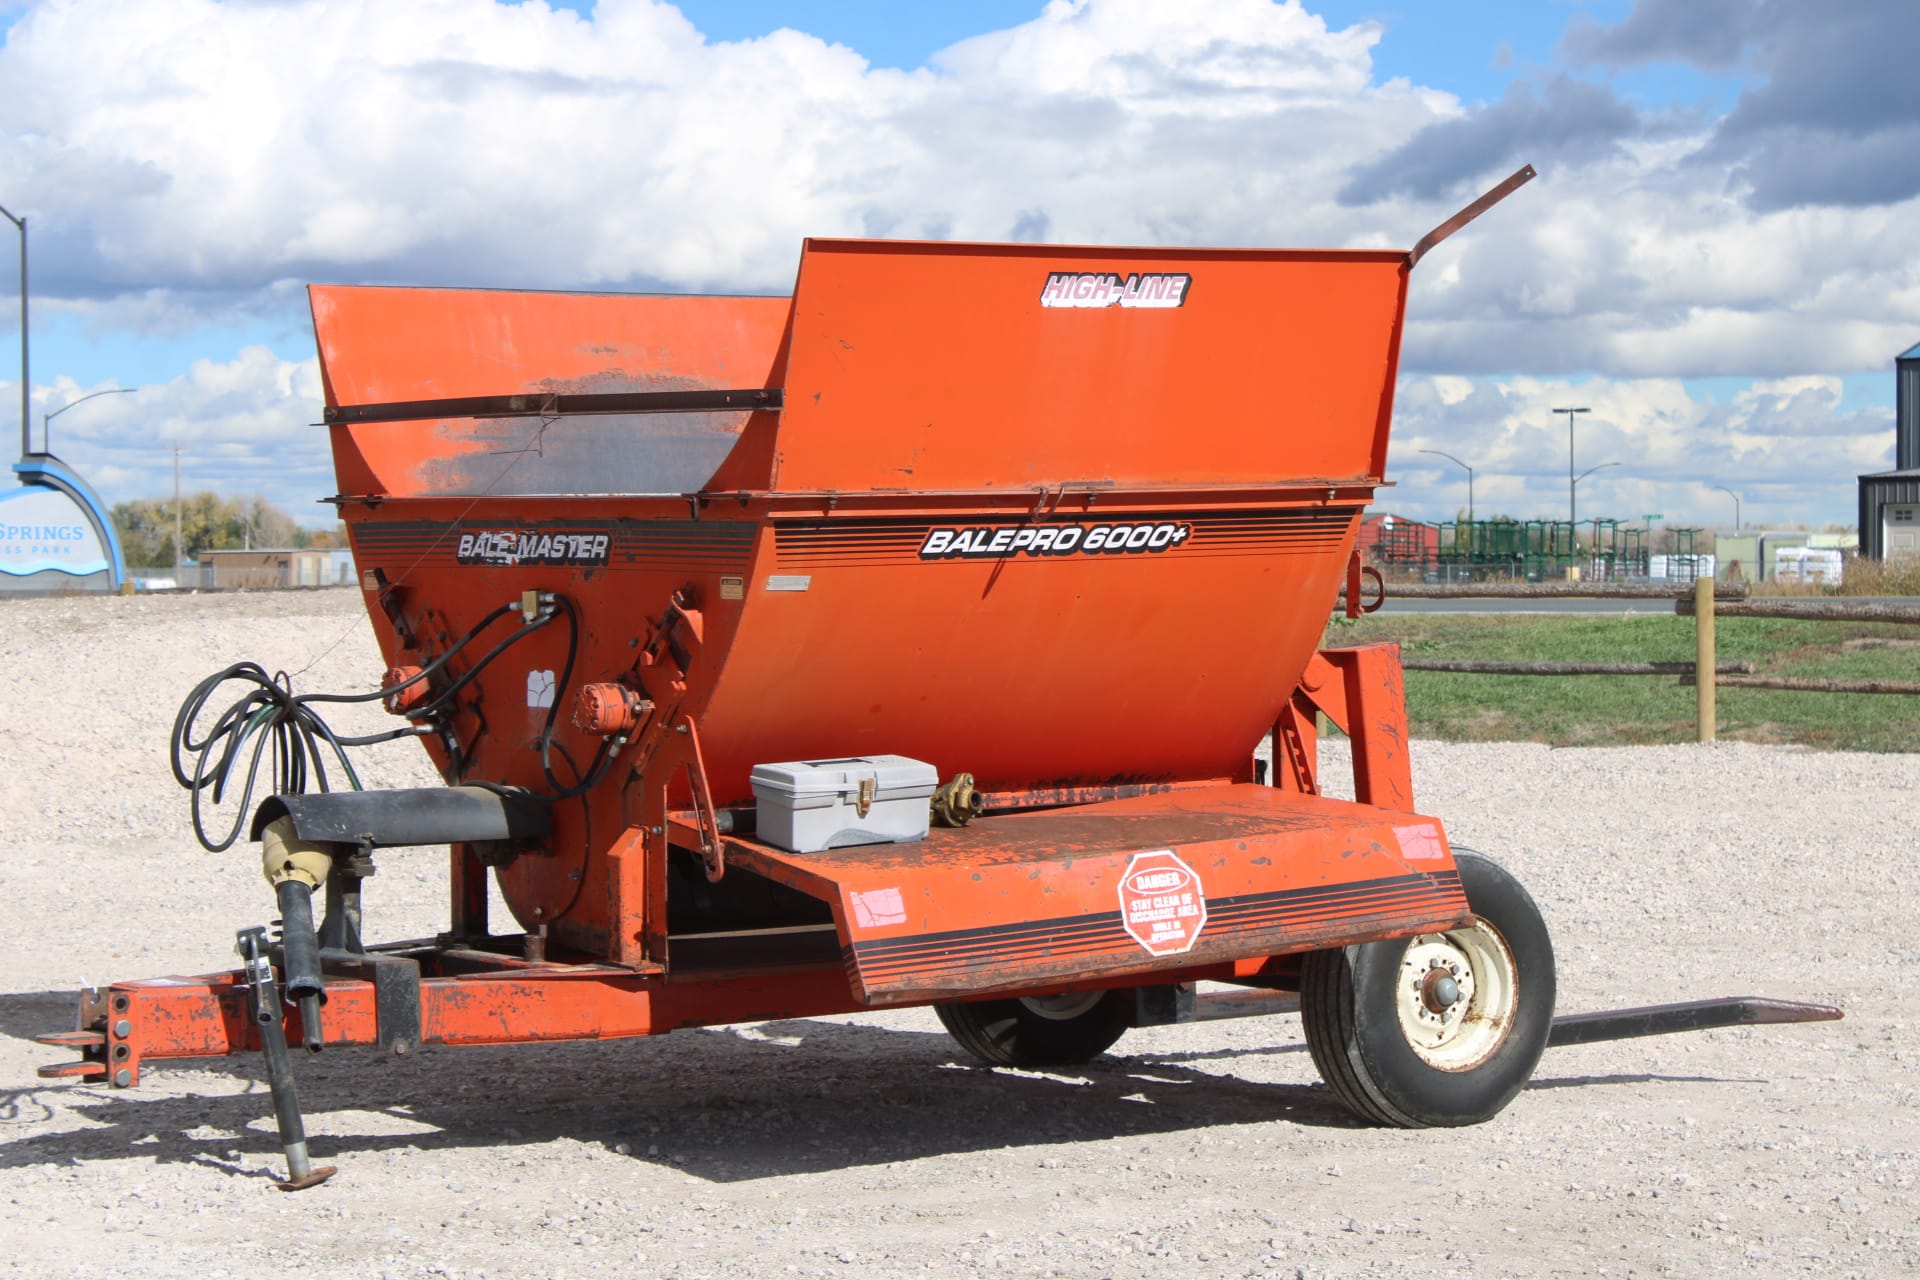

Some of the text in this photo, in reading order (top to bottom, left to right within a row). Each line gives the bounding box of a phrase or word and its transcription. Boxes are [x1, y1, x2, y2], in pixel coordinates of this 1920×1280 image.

[1042, 273, 1190, 306] HIGH-LINE
[0, 523, 84, 541] SPRINGS
[922, 524, 1188, 555] BALEPRO 6000+
[32, 545, 71, 555] PARK
[517, 534, 609, 560] MASTER
[1136, 872, 1181, 890] DANGER
[1131, 892, 1193, 912] STAY CLEAR OF
[1177, 904, 1199, 917] AREA
